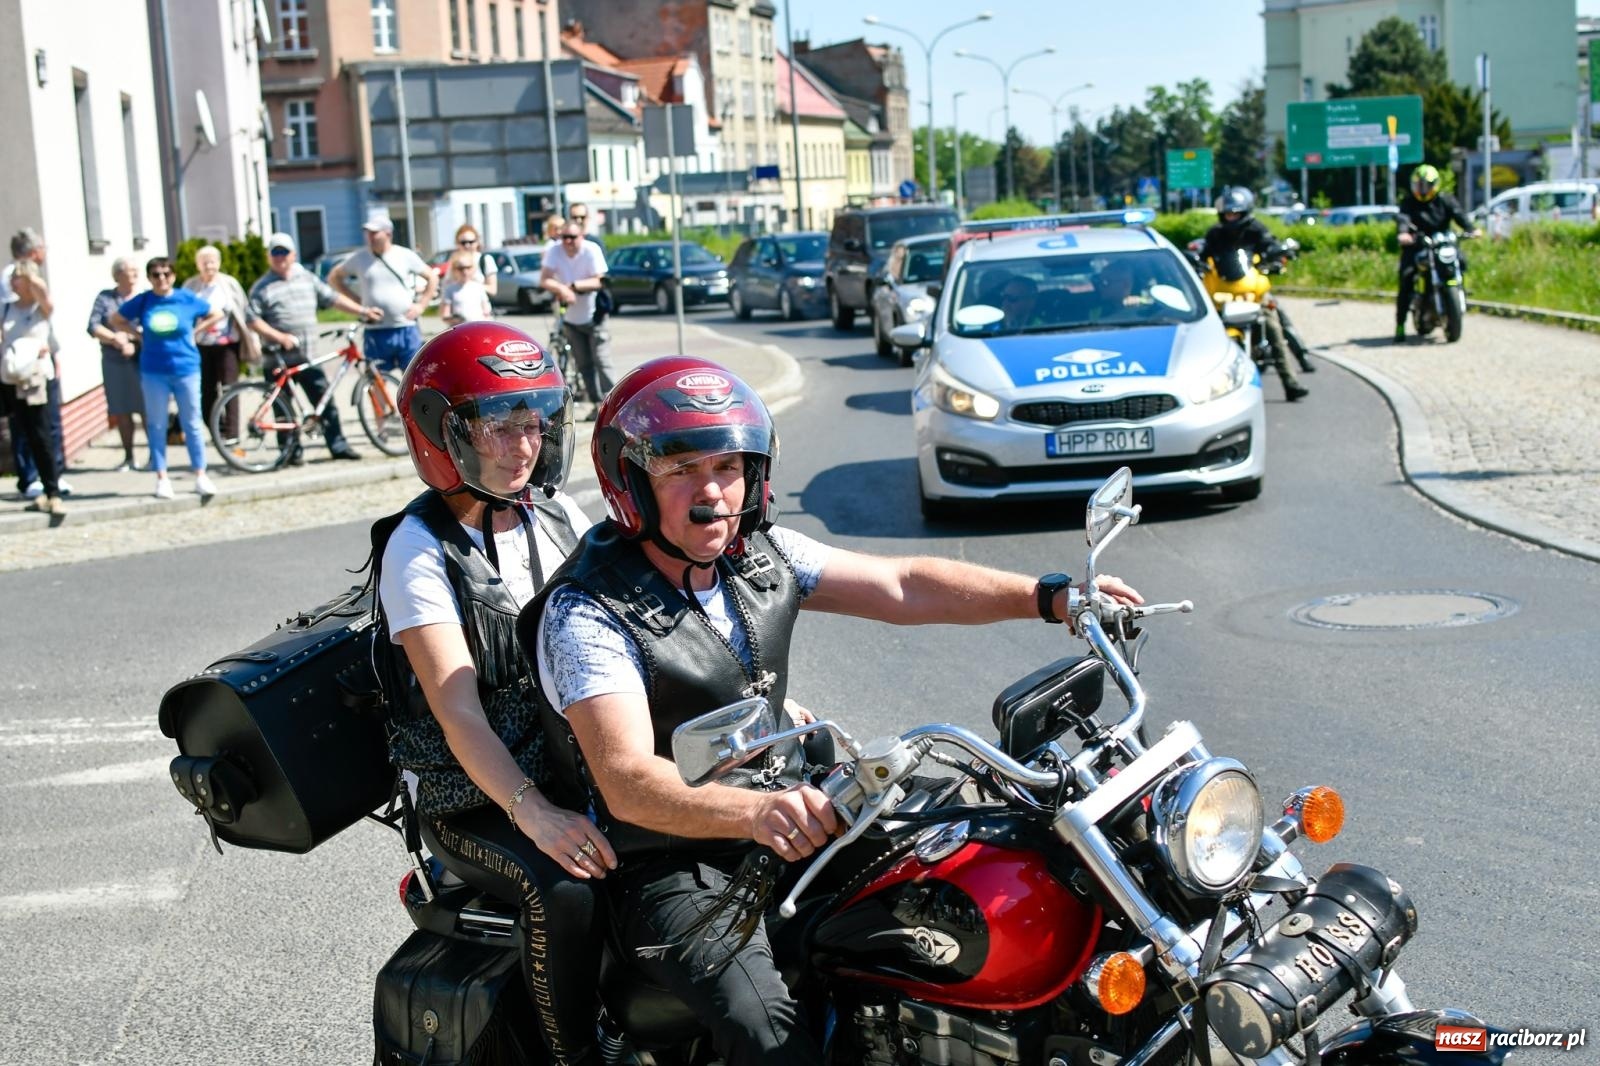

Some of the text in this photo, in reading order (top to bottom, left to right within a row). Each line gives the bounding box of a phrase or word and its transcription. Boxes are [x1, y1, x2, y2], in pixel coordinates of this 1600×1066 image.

[1035, 361, 1147, 382] POLICJA
[1058, 430, 1151, 453] HPP R014
[484, 848, 503, 873] ELITE
[530, 928, 547, 958] LADY
[1294, 912, 1368, 984] BOSS
[532, 973, 551, 1007] ELITE
